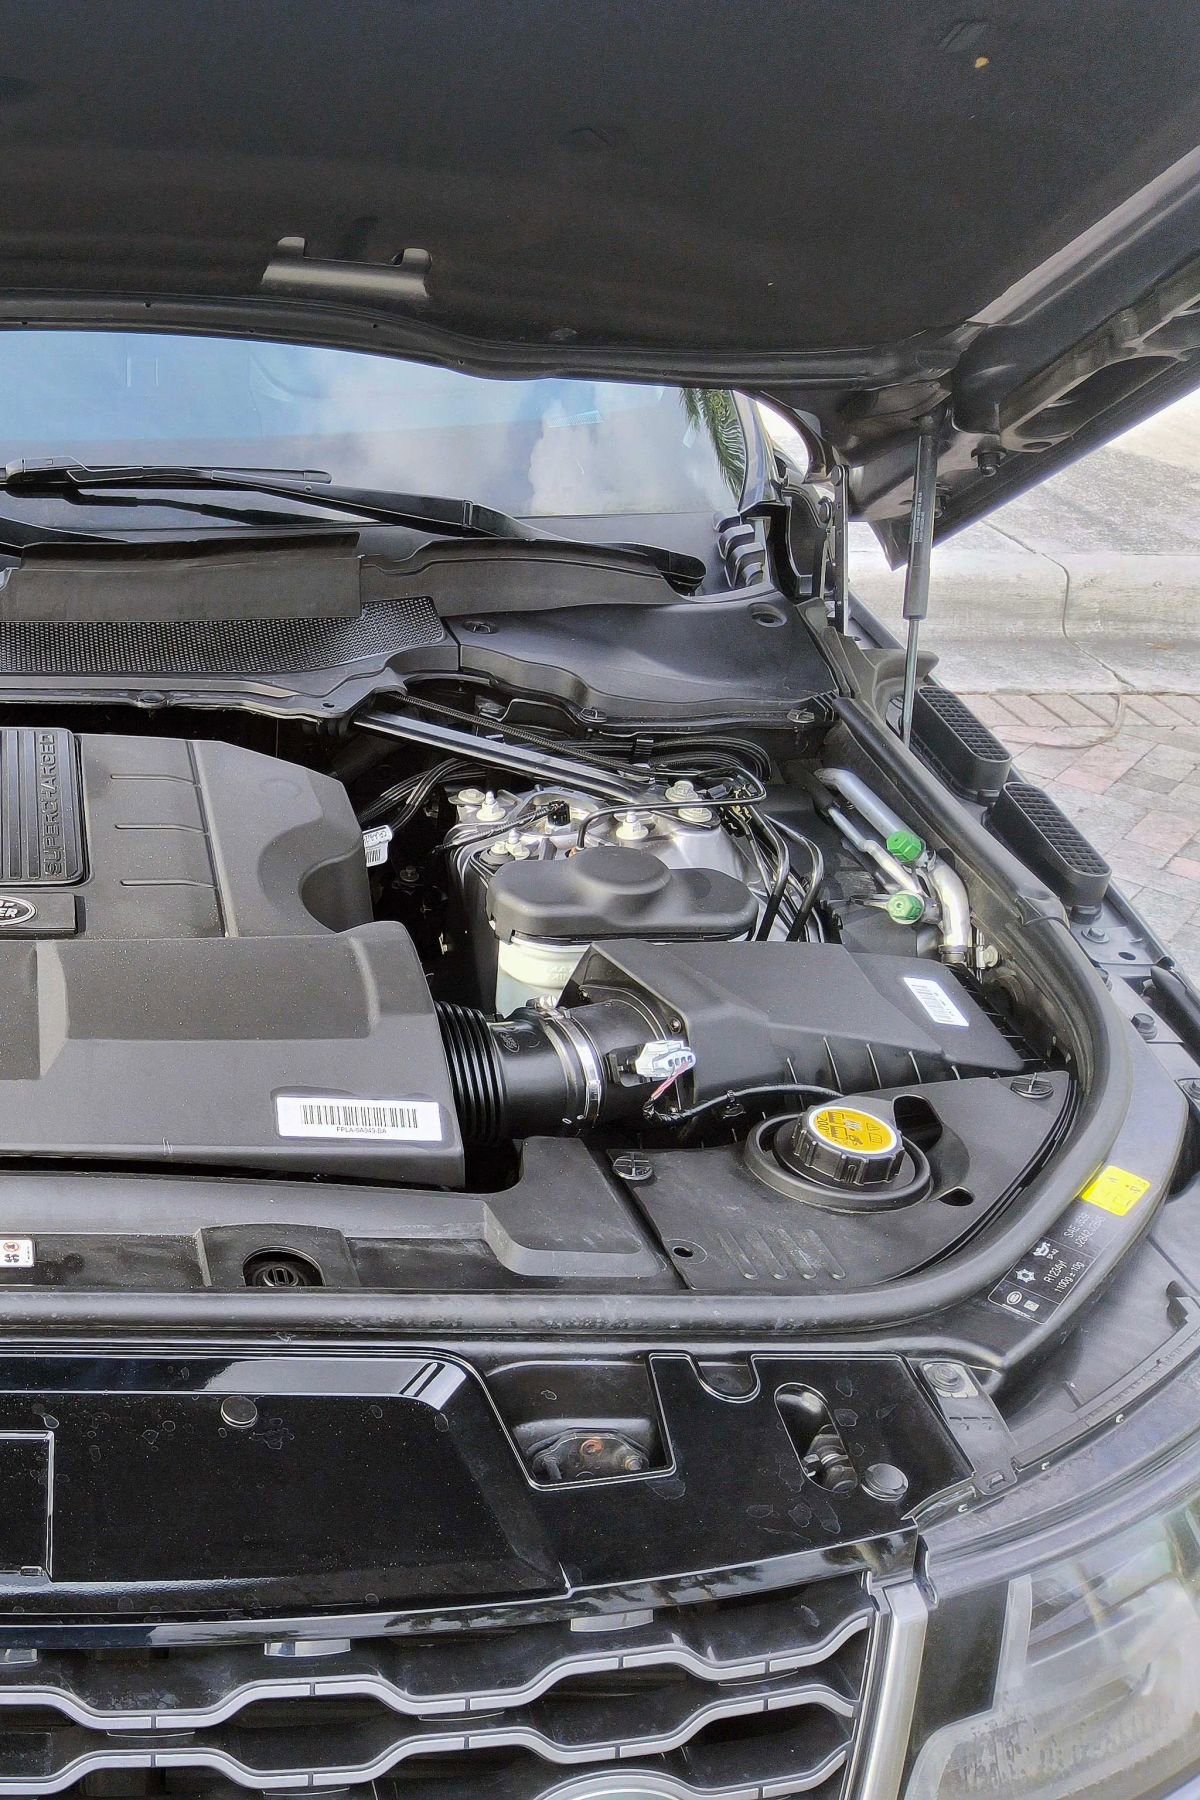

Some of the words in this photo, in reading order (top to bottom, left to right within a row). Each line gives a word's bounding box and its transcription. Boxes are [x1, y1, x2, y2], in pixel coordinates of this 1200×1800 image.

[40, 733, 65, 876] SUPERCHARGED
[816, 1115, 830, 1133] 200
[1043, 1260, 1068, 1284] R1234yf
